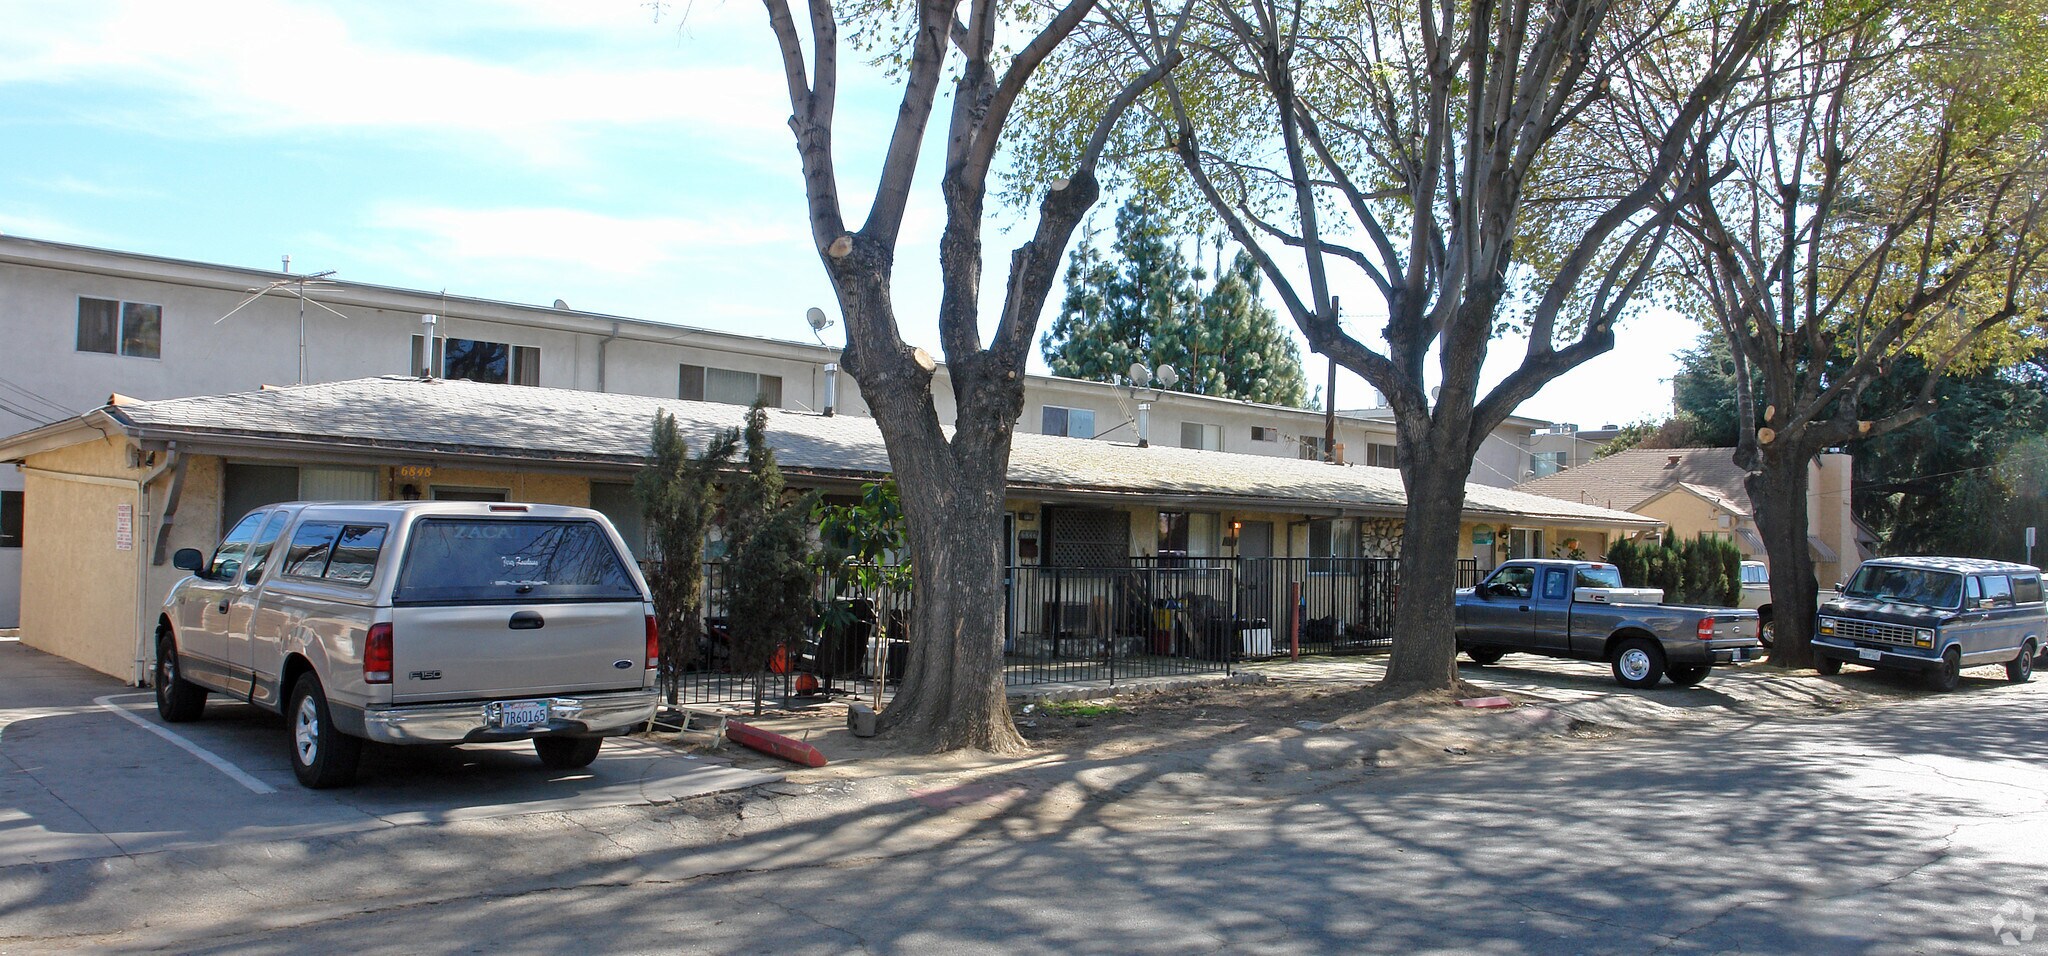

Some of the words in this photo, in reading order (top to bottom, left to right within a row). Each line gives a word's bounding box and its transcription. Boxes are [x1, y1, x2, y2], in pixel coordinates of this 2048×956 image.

[401, 465, 432, 478] 6848
[409, 669, 442, 681] F150
[504, 709, 545, 725] 7R60165
